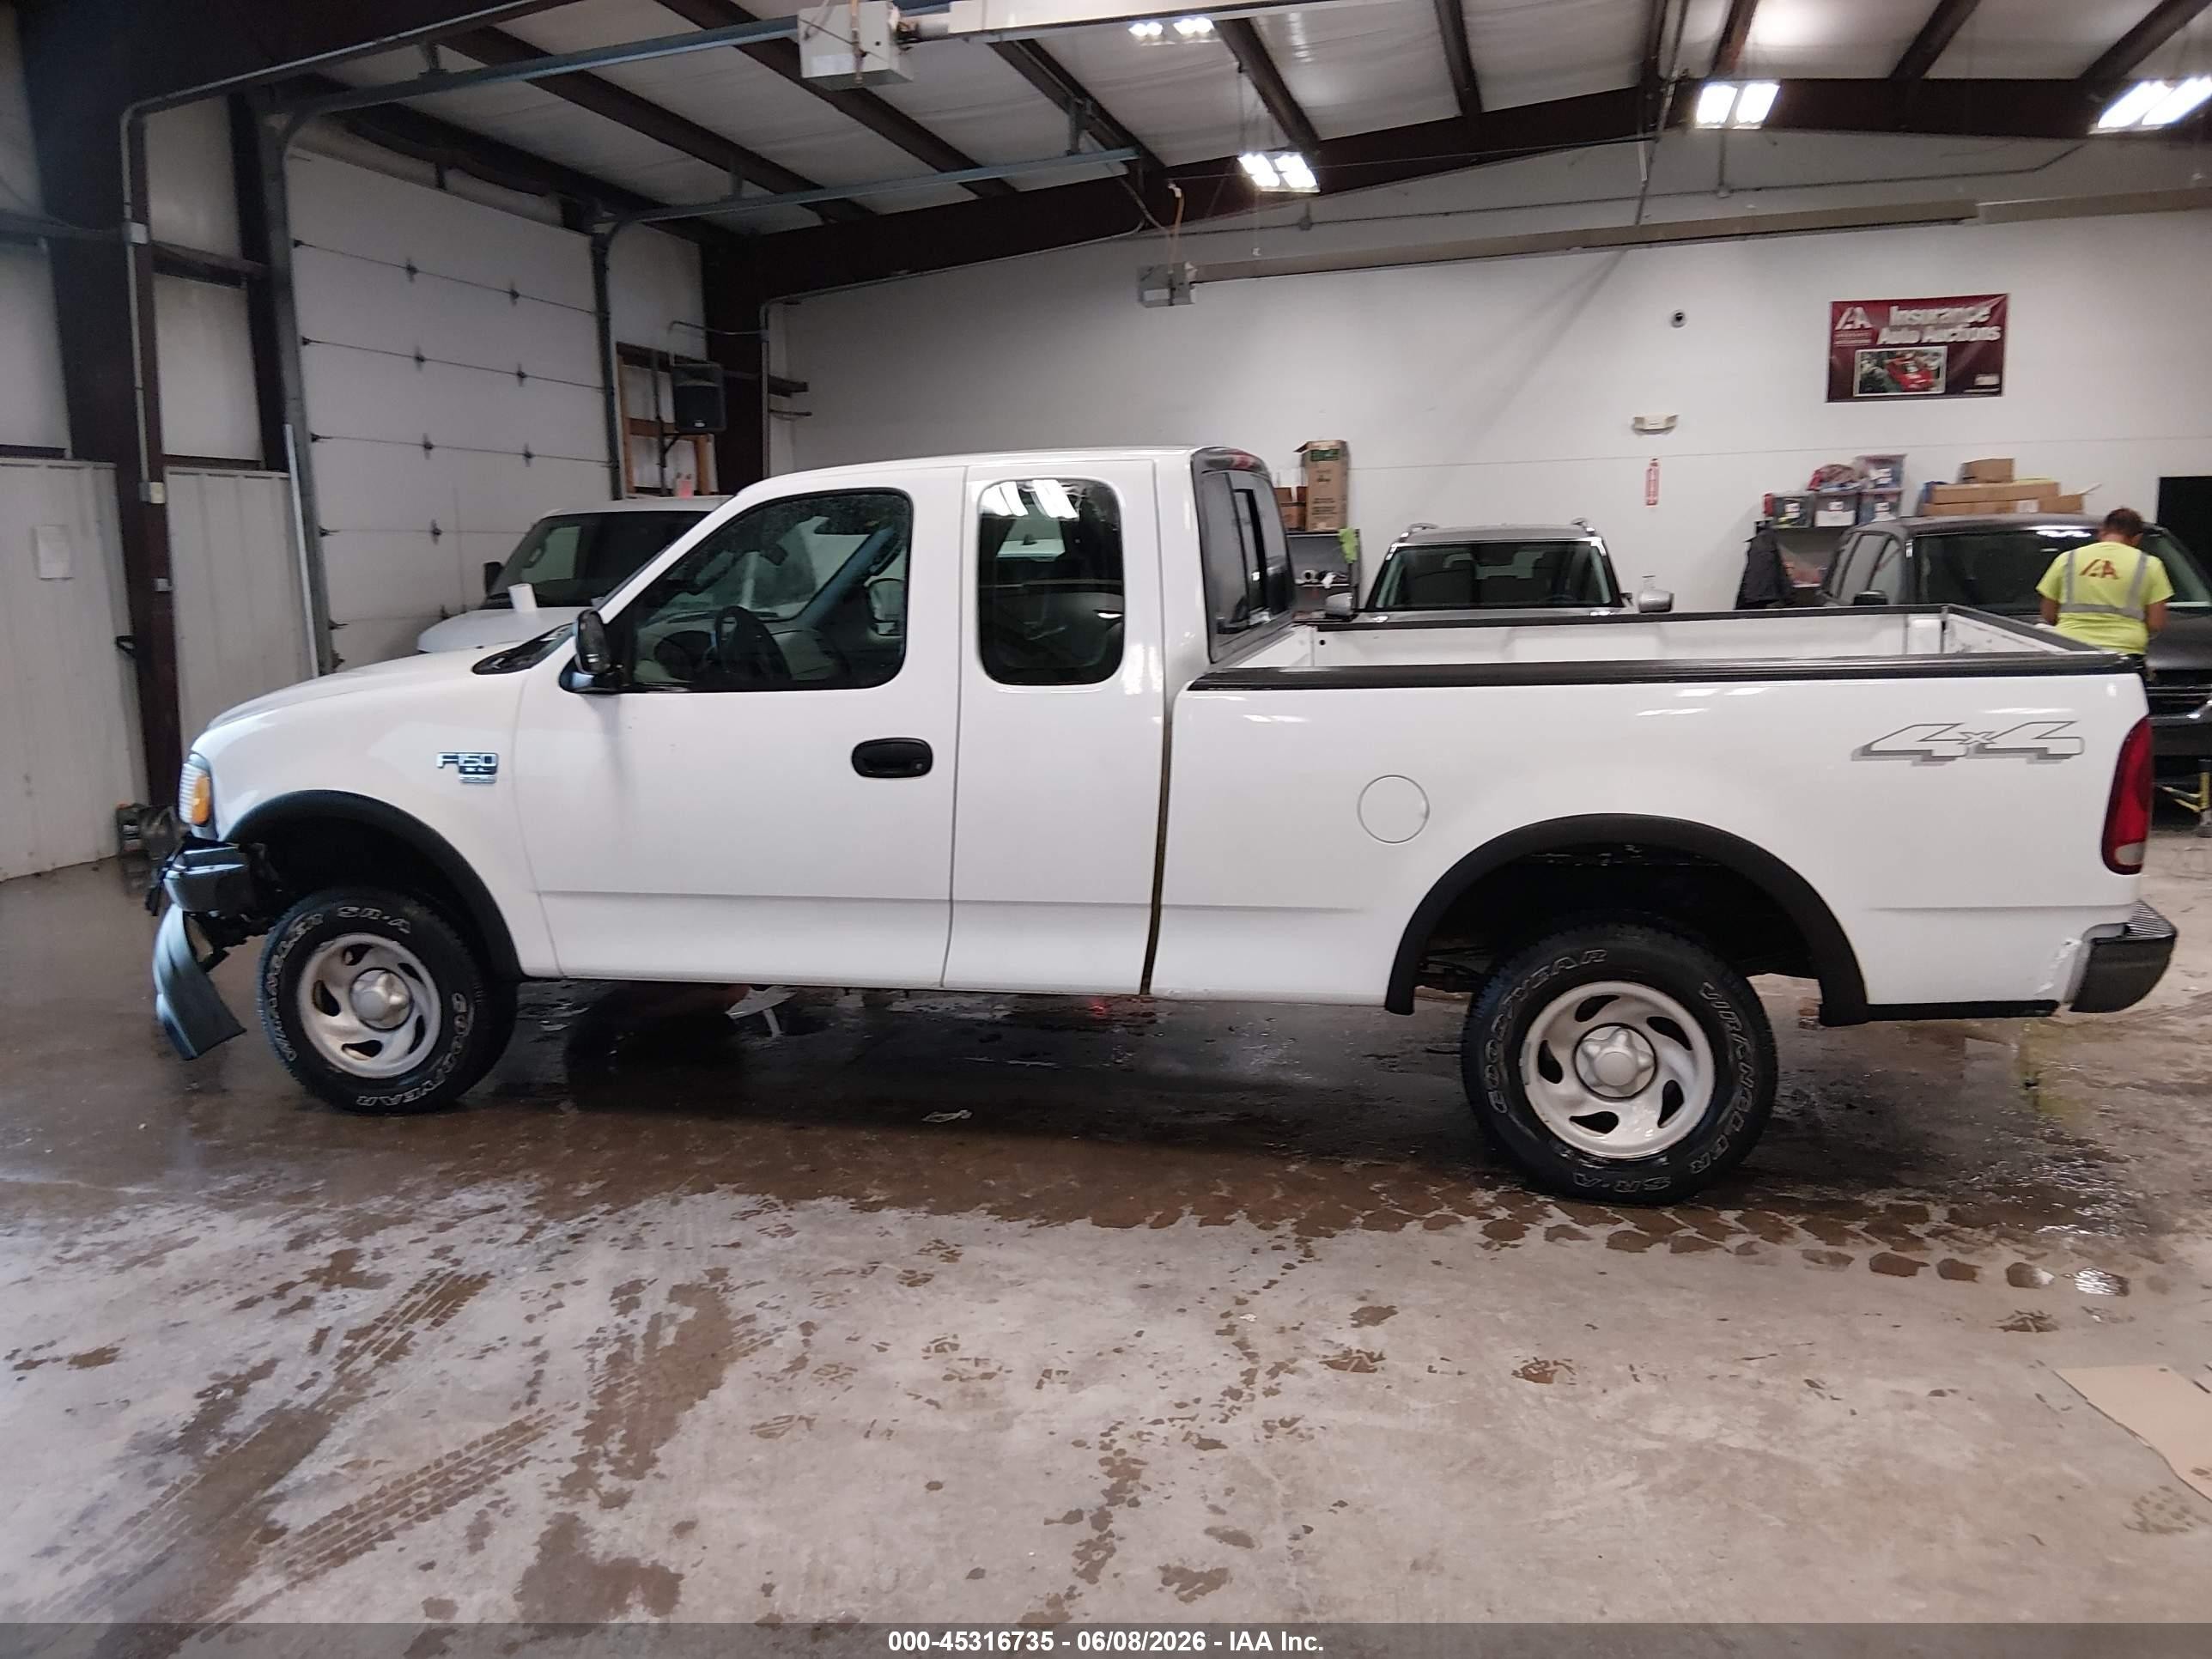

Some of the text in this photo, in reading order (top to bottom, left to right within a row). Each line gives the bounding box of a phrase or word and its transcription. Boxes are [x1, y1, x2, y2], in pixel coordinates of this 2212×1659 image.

[1888, 305, 1993, 329] Insurance
[1876, 326, 1921, 345] Auto
[1919, 325, 2002, 344] Auctions
[1851, 720, 2086, 766] 4x4
[1484, 948, 1608, 1115] GOODYEAR
